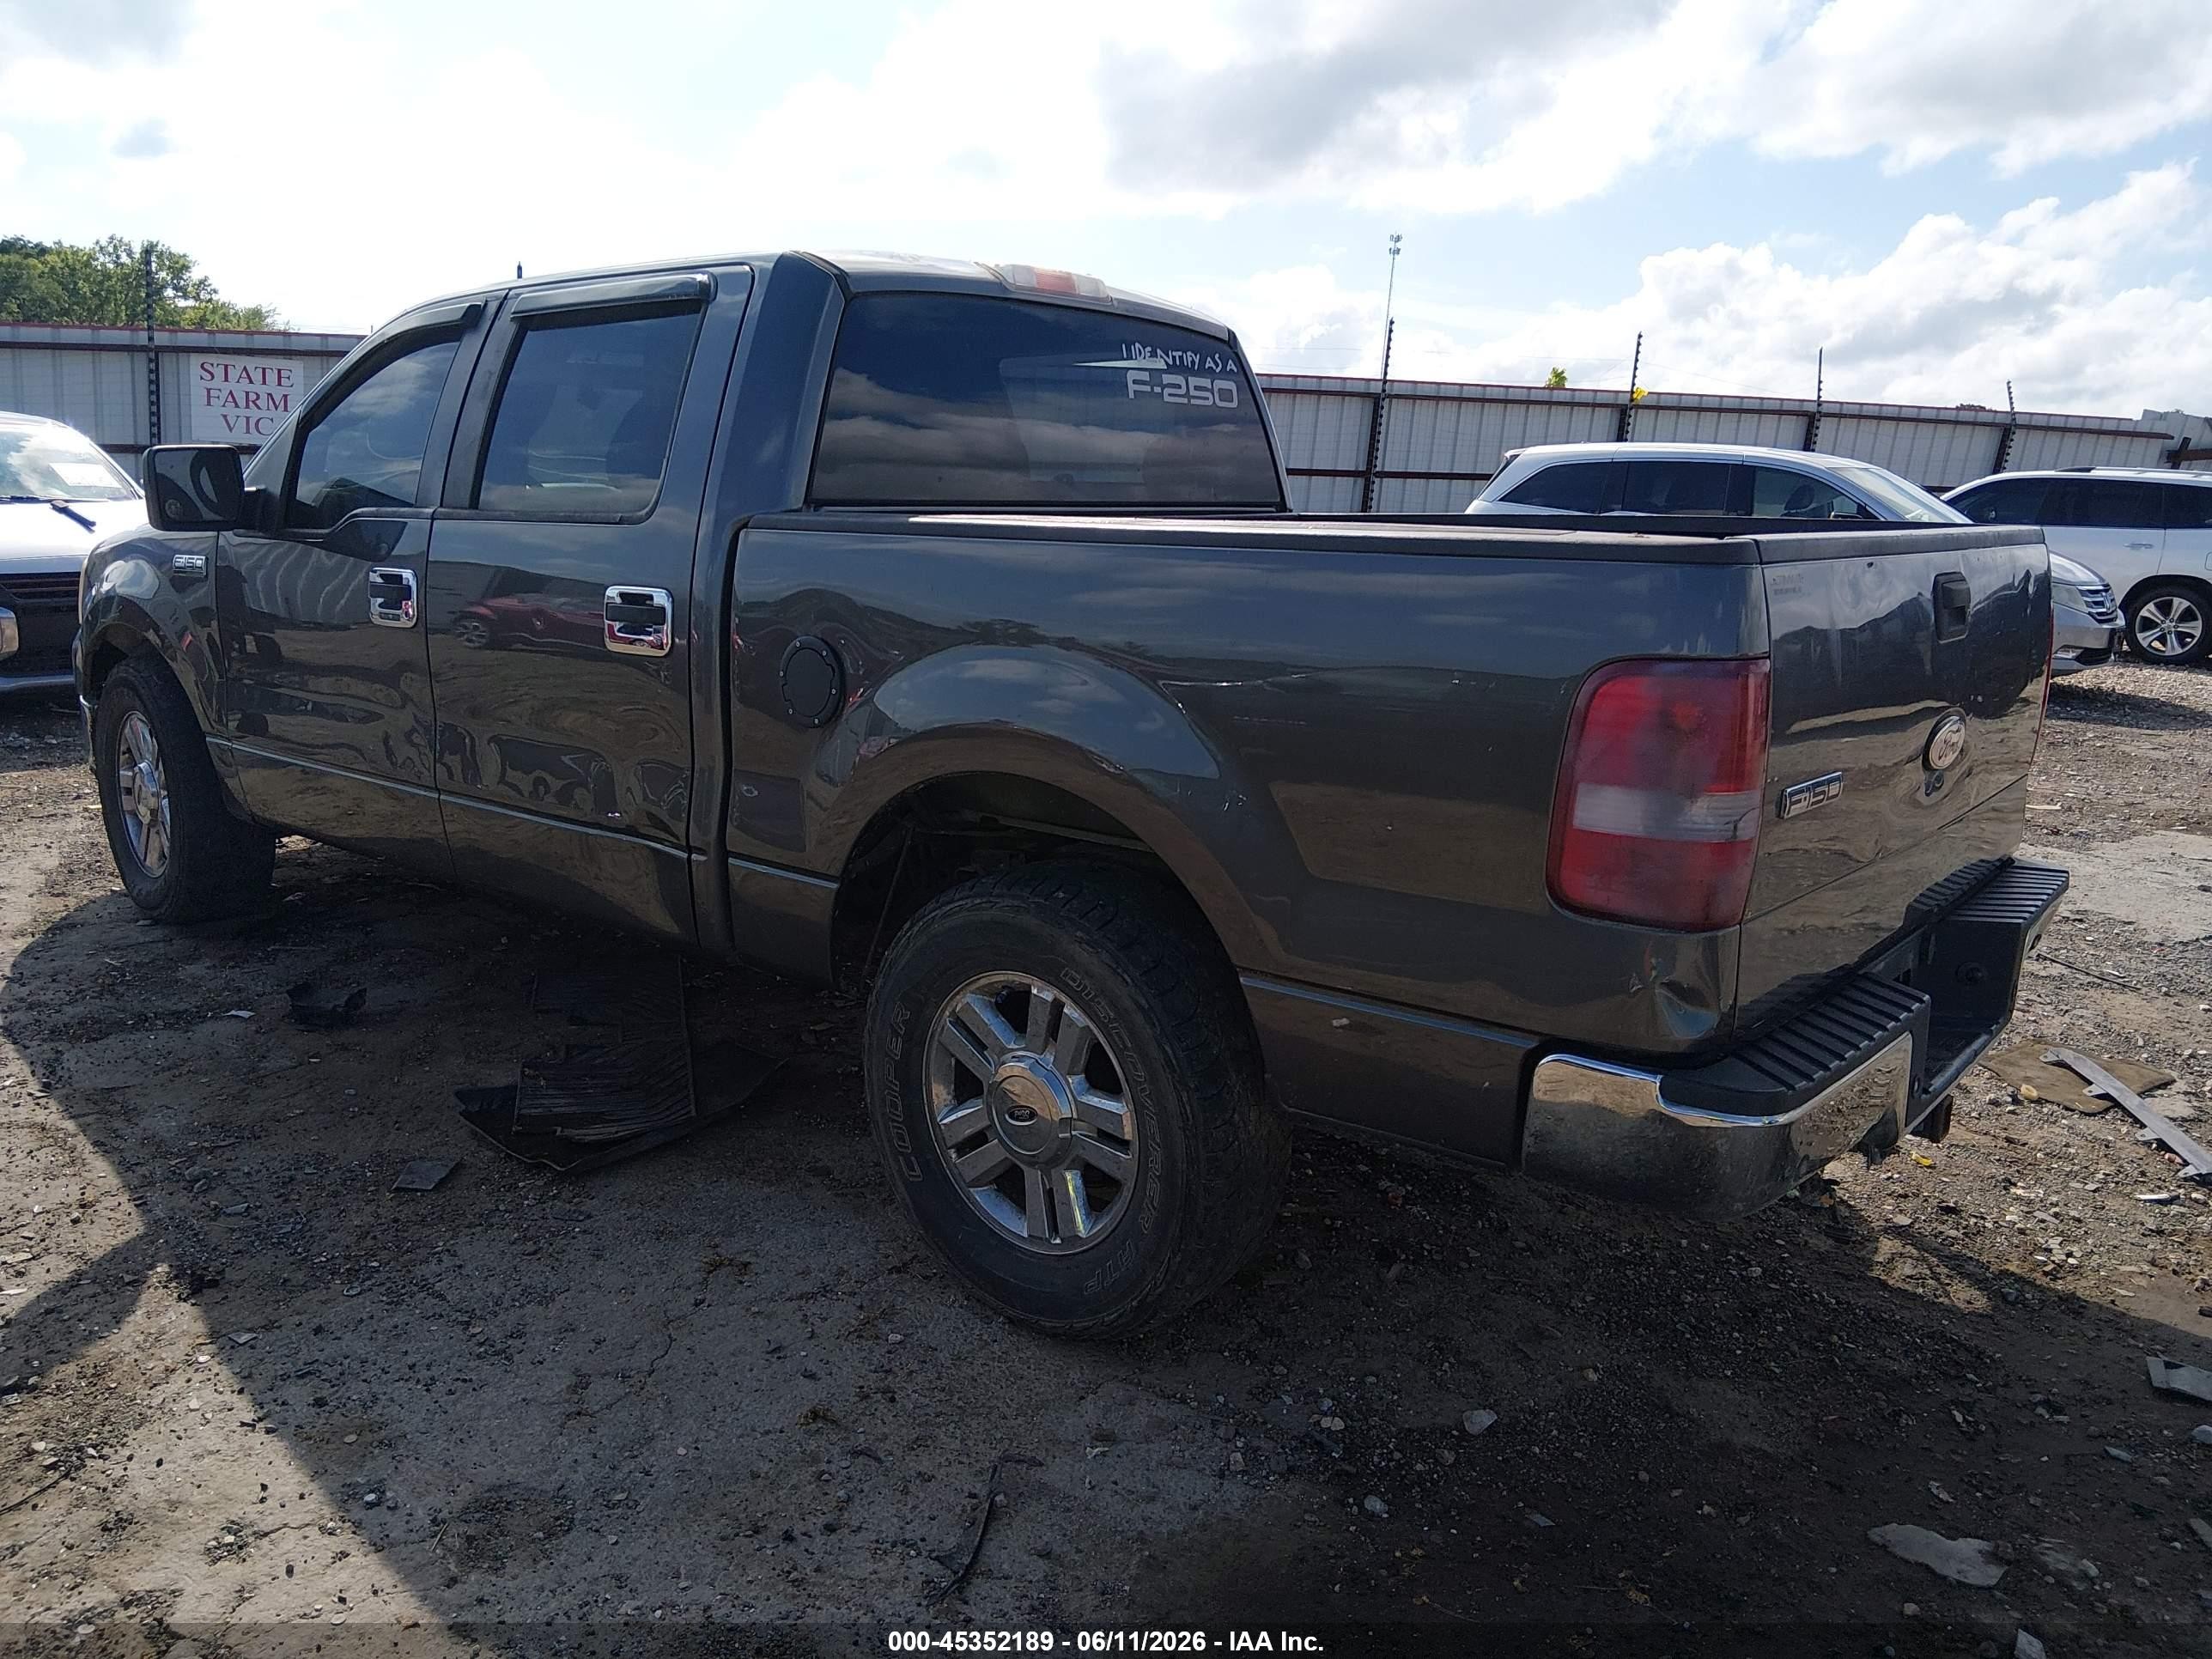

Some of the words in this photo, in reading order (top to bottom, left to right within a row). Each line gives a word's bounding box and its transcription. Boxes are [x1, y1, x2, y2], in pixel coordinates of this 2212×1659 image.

[199, 361, 294, 387] STATE
[1121, 343, 1127, 359] I
[1131, 342, 1200, 370] IDENTIFY
[1205, 353, 1222, 373] AS
[1226, 359, 1237, 373] A
[204, 387, 291, 412] FARM
[1127, 369, 1238, 408] F-250
[220, 413, 274, 436] VIC
[1935, 723, 1963, 763] Ford
[884, 1001, 923, 1182] COOPER
[1060, 968, 1164, 1234] DISCOVERER
